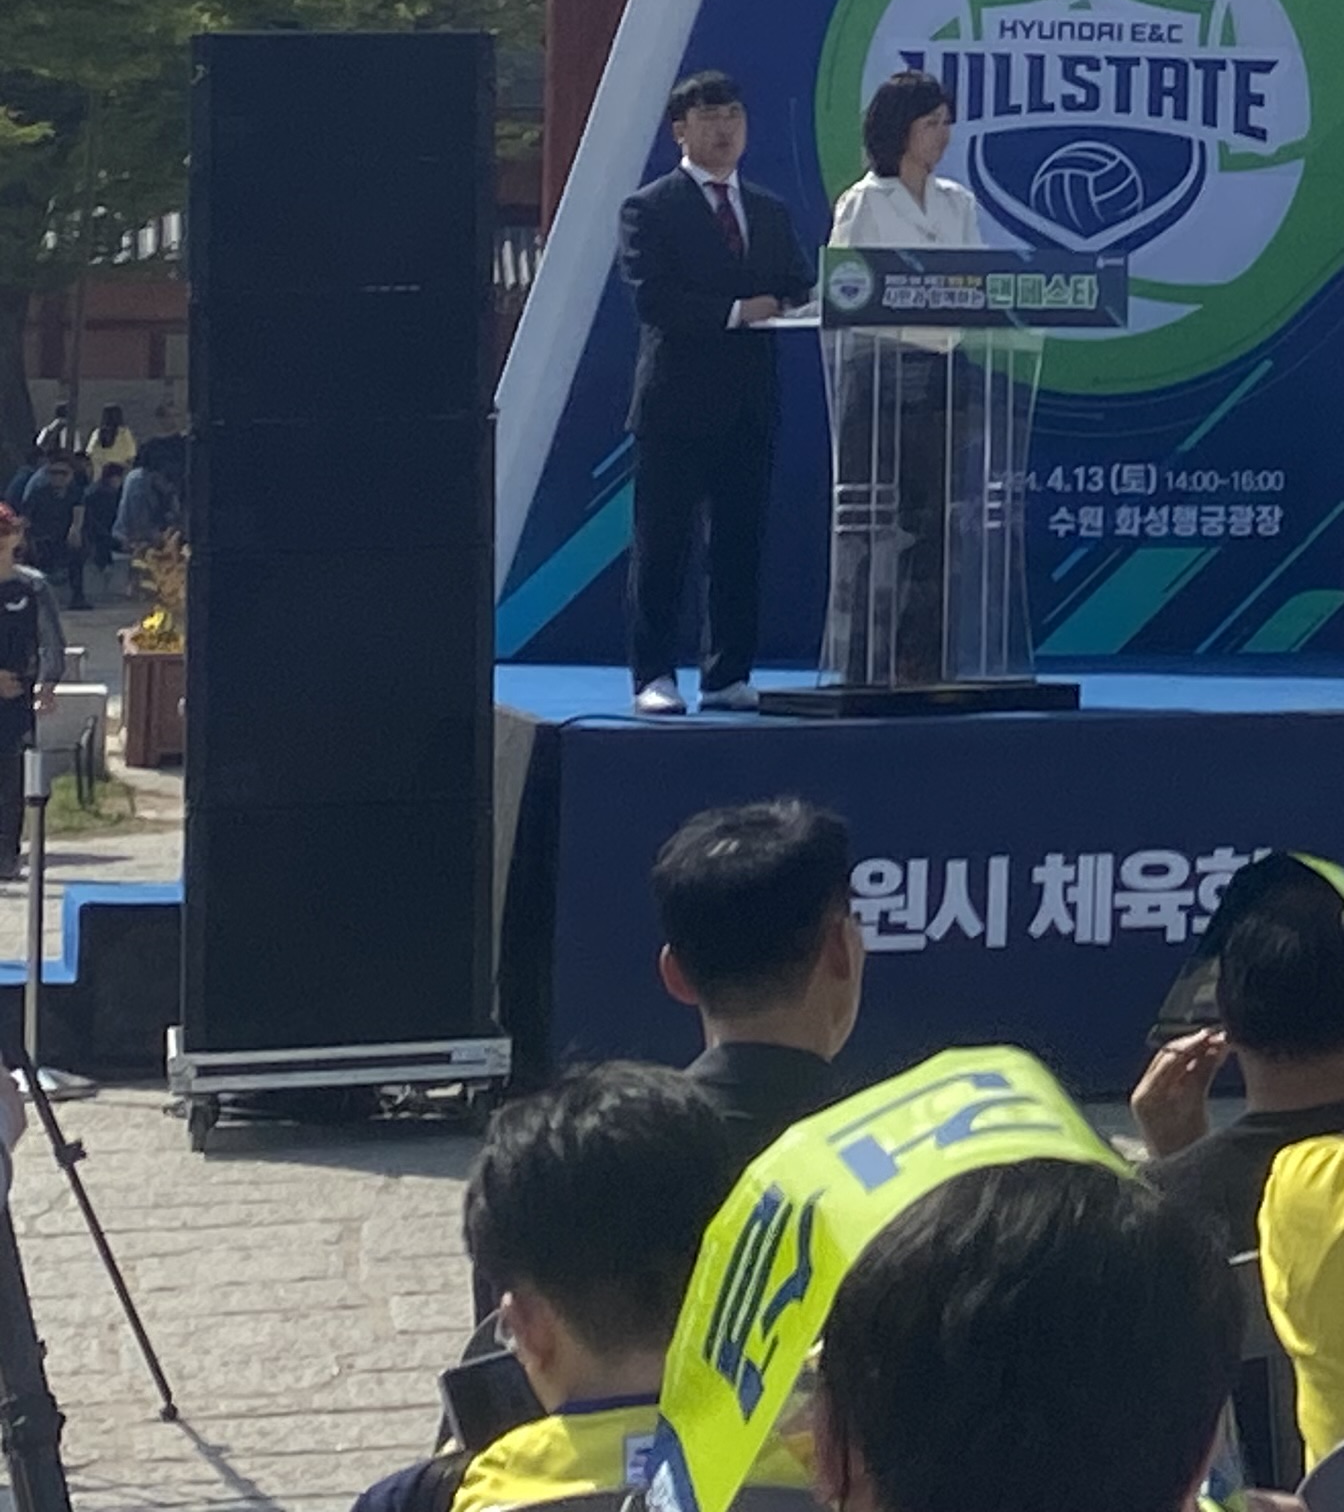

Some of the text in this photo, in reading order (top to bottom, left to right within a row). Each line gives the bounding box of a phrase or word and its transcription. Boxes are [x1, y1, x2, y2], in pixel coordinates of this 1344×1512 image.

[1000, 20, 1183, 44] HYUNDAI E&C
[1047, 467, 1103, 491] 4.13
[1111, 464, 1157, 494] (토)
[1049, 505, 1283, 538] 수원 화성행궁광장
[849, 855, 1009, 952] 원시
